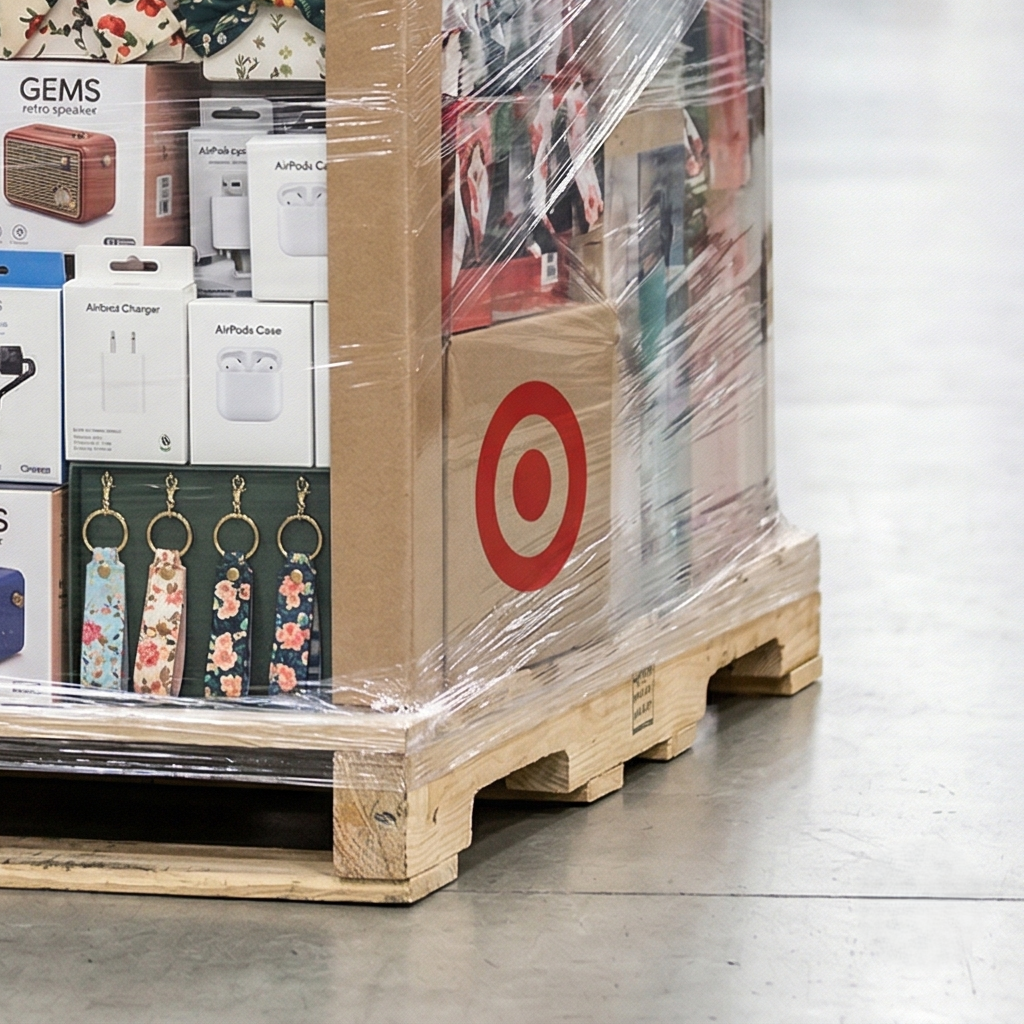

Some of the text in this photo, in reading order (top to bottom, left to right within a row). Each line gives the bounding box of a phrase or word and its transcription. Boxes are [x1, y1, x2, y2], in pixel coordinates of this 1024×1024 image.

[19, 76, 101, 102] GEMS
[22, 104, 97, 117] retro speaker
[214, 324, 282, 336] AirPods Case
